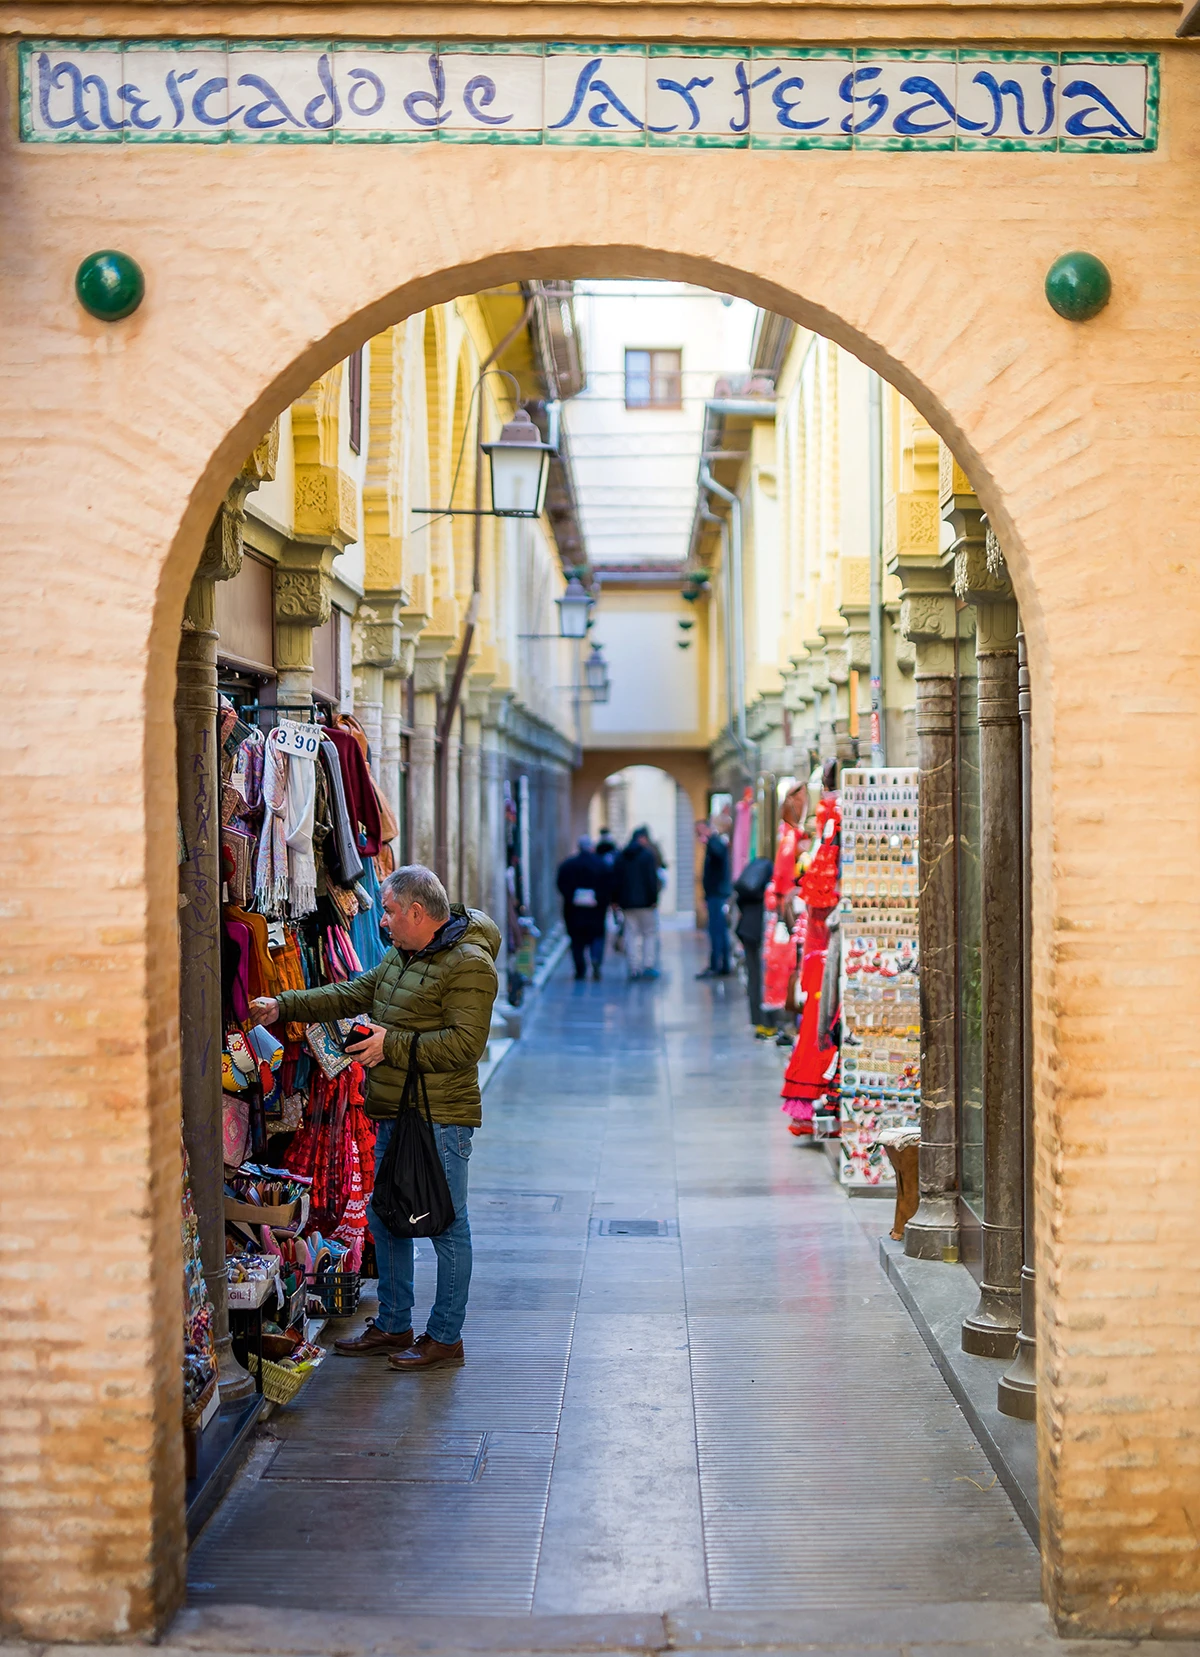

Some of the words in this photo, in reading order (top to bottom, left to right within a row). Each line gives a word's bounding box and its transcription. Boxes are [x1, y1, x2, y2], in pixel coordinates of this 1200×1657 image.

[37, 52, 387, 130] Mercado
[402, 53, 514, 127] de
[547, 58, 1143, 138] Artesania
[277, 730, 317, 752] 3.90
